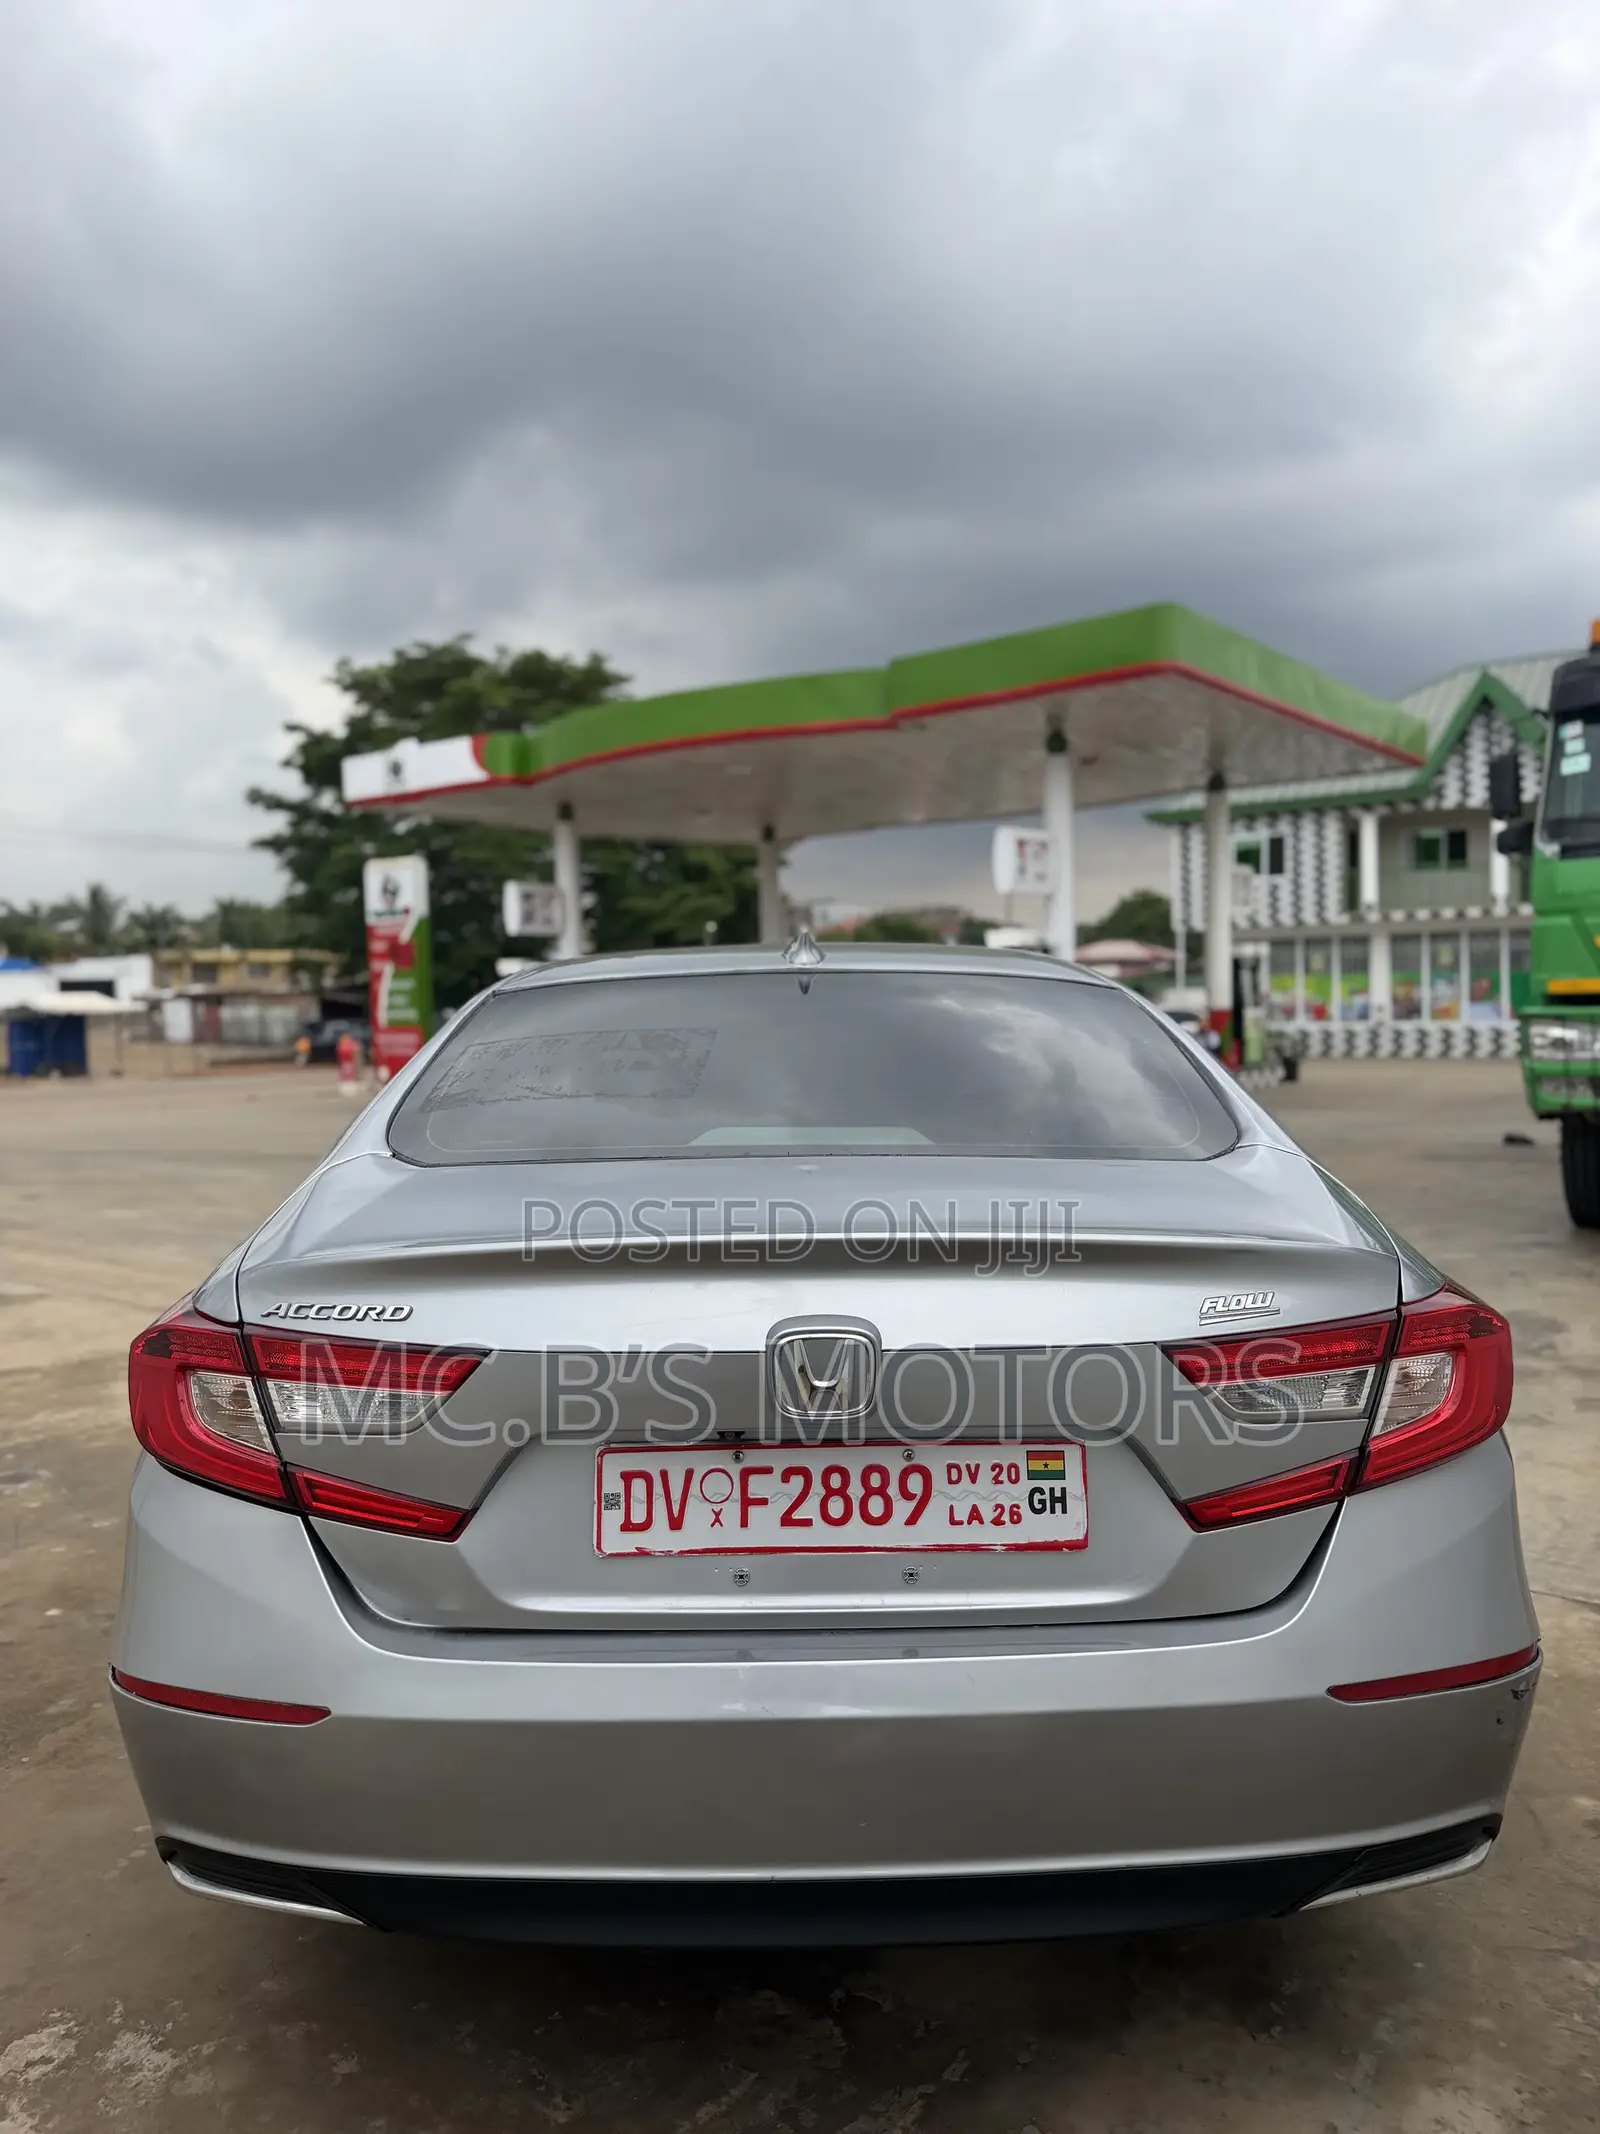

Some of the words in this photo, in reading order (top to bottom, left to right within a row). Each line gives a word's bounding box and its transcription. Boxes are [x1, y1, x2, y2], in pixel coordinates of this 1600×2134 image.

[261, 1302, 413, 1322] ACCORD
[1199, 1291, 1275, 1315] FLOW
[946, 1462, 981, 1485] DV
[990, 1462, 1021, 1485] 20
[620, 1467, 695, 1532] DV
[739, 1462, 933, 1529] F2889
[1028, 1486, 1068, 1515] GH
[948, 1503, 985, 1527] LA
[990, 1503, 1023, 1527] 26
